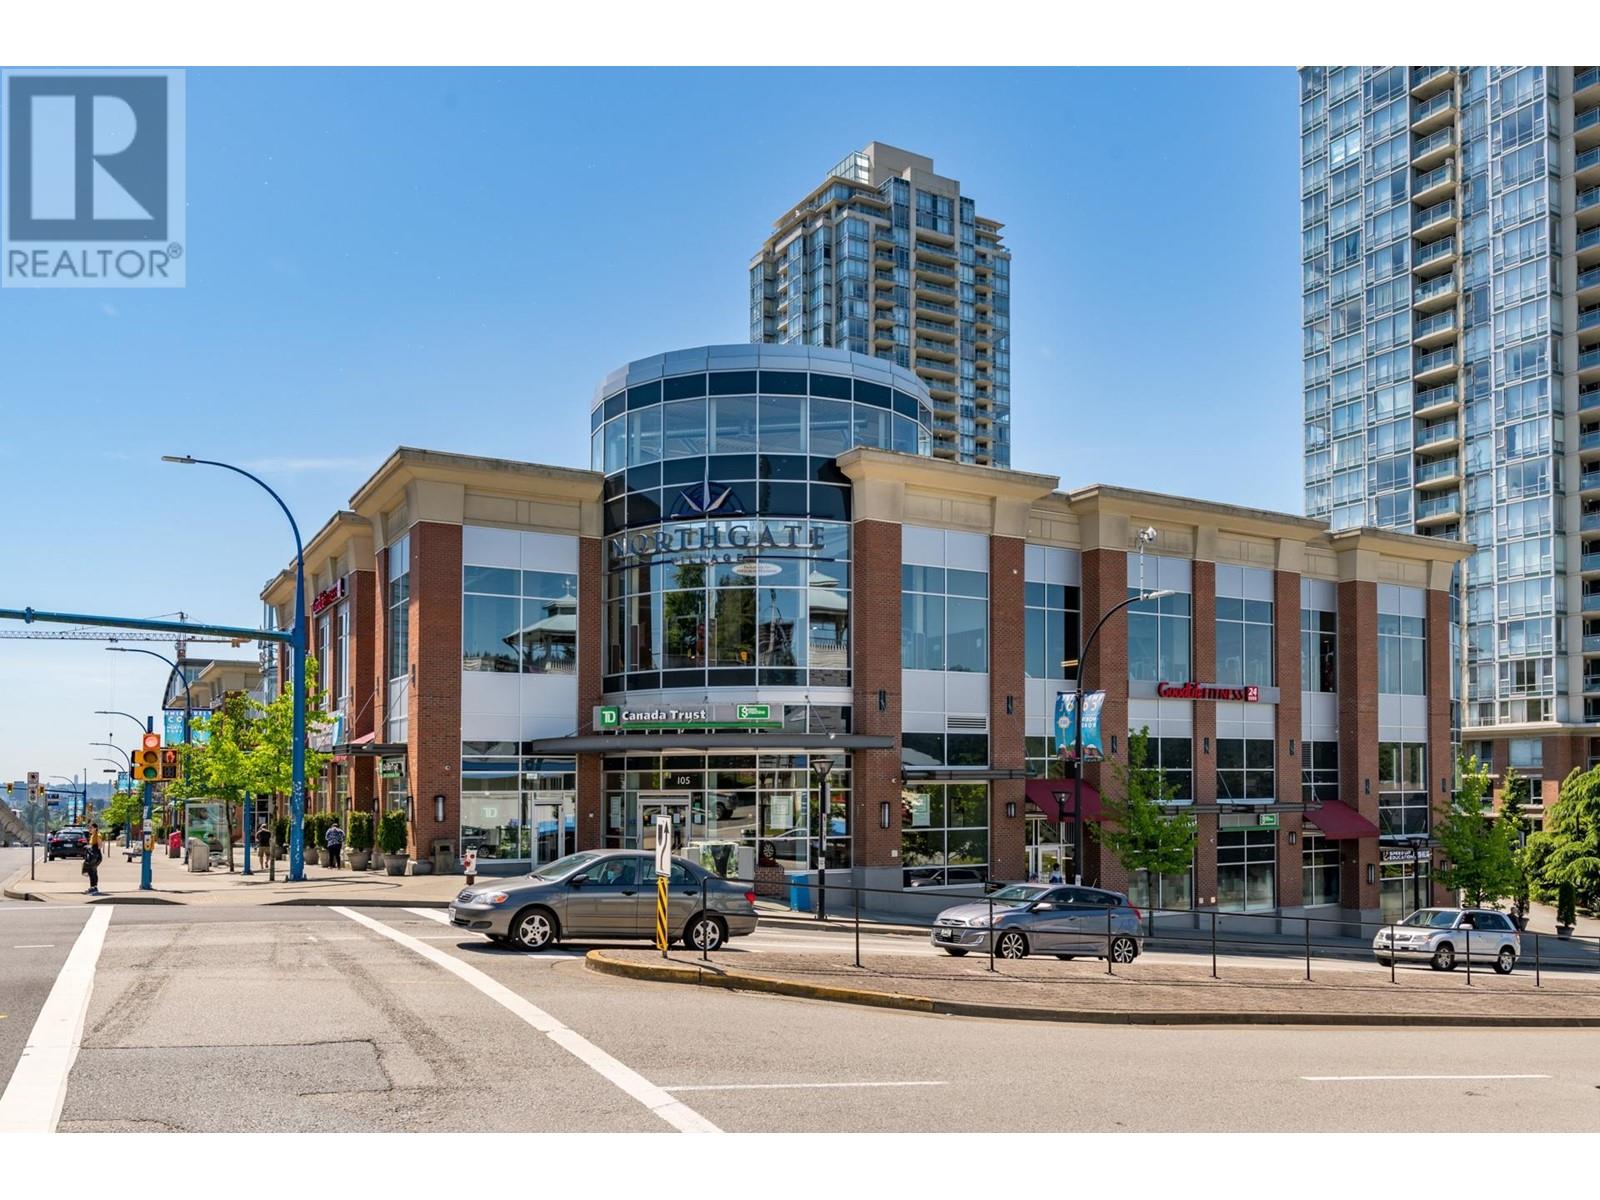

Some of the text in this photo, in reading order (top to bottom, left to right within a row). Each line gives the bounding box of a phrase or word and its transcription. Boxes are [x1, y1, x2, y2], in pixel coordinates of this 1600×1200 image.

[611, 524, 825, 558] NORTHGATE
[672, 553, 744, 564] VILLAGE
[1247, 687, 1258, 696] 24
[602, 709, 707, 723] TD Canada Trust
[677, 775, 691, 785] 105
